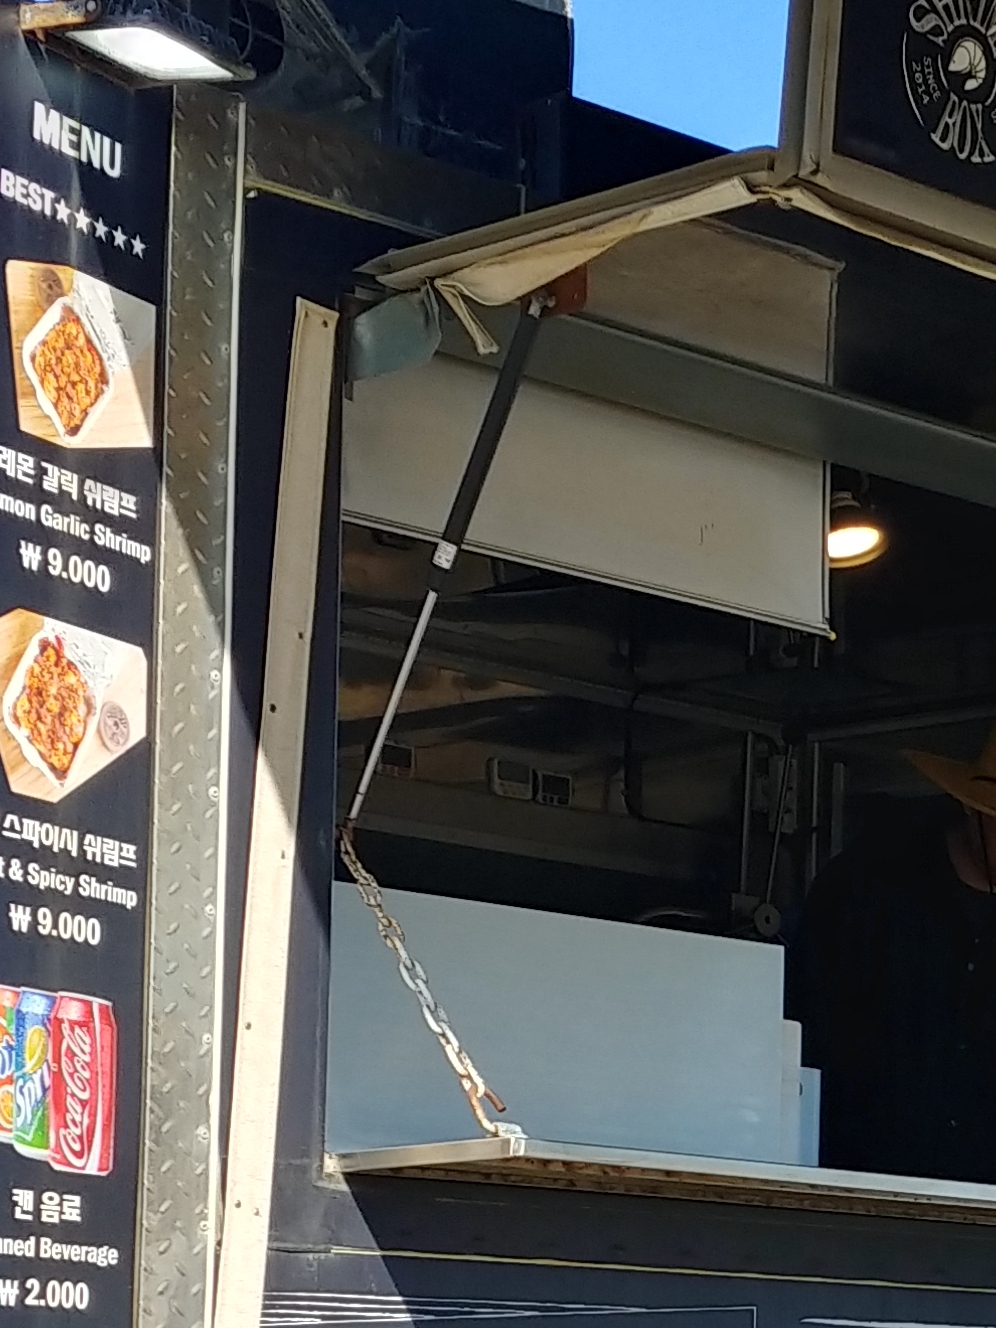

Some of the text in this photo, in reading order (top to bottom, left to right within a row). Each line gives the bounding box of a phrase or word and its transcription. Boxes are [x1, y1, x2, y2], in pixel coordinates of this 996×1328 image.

[912, 61, 930, 104] 2014
[923, 56, 942, 102] SINCE
[33, 100, 122, 178] MENU
[930, 91, 996, 163] BOX
[40, 460, 79, 501] 갈릭
[83, 477, 138, 519] 쉬림프
[40, 503, 91, 541] Garlic
[93, 522, 151, 564] Shrimp
[47, 547, 111, 593] 9.000
[2, 813, 138, 868] 스파이시 쉬림프
[8, 858, 24, 882] &
[26, 862, 76, 895] Spicy
[78, 873, 138, 910] Shrimp
[37, 906, 101, 946] 9.000
[11, 1188, 82, 1223] 캔 음료
[39, 1236, 119, 1268] Beverage
[24, 1277, 90, 1310] 2.000
